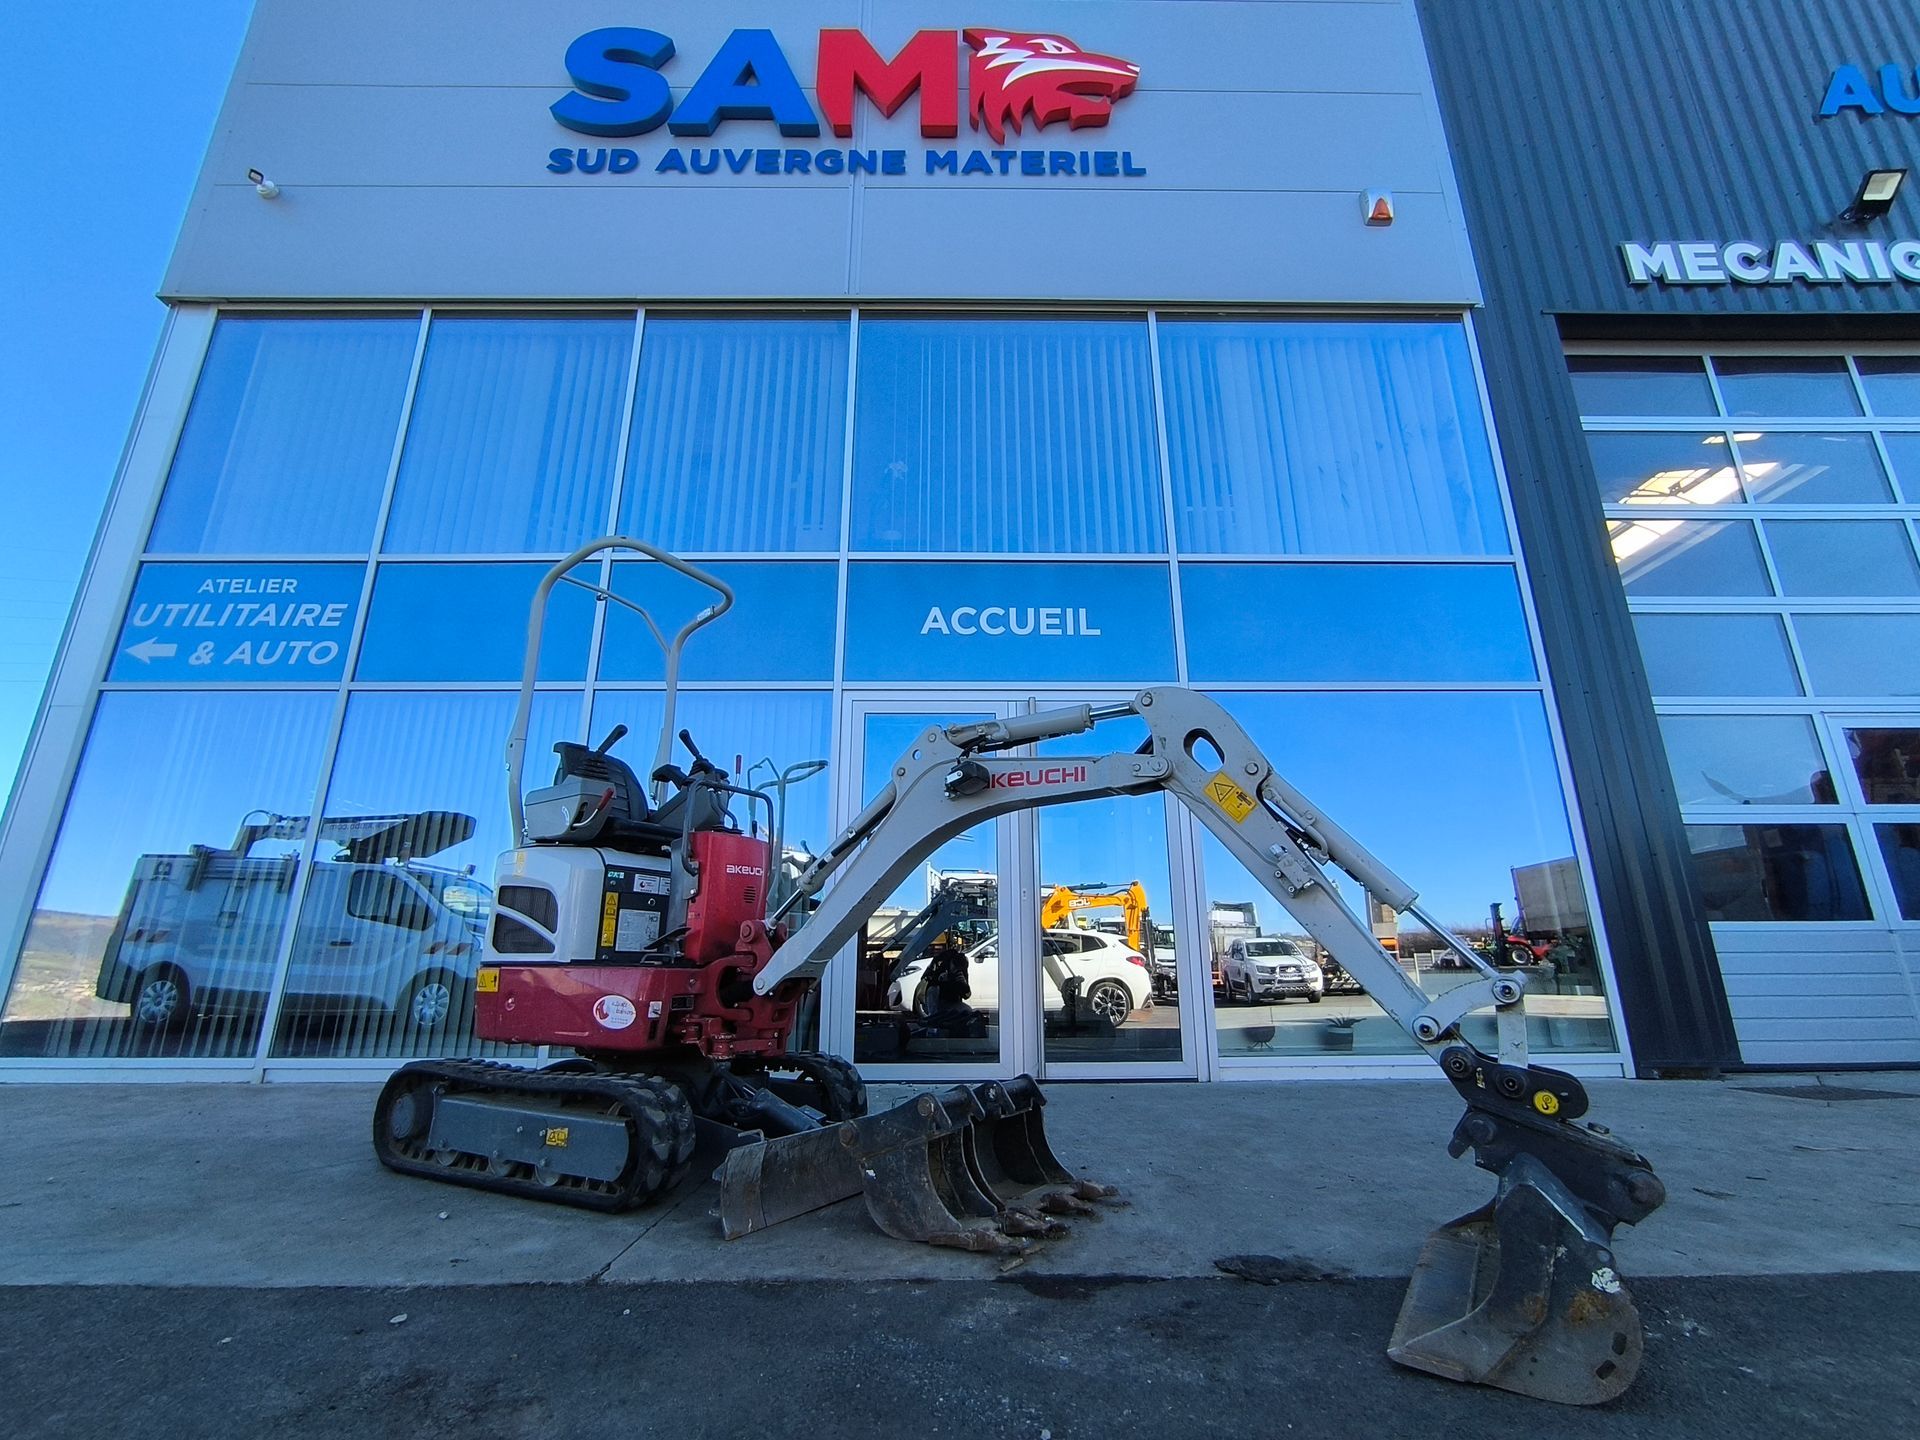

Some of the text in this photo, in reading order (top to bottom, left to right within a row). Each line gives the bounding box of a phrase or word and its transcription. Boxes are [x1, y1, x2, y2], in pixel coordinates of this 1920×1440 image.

[549, 26, 958, 138] SAM
[547, 148, 1147, 177] SUD AUVERGNE MATERIEL
[197, 578, 298, 594] ATELIER
[133, 603, 348, 627] UTILITAIRE
[920, 606, 1101, 636] ACCUEIL
[188, 640, 339, 665] & AUTO
